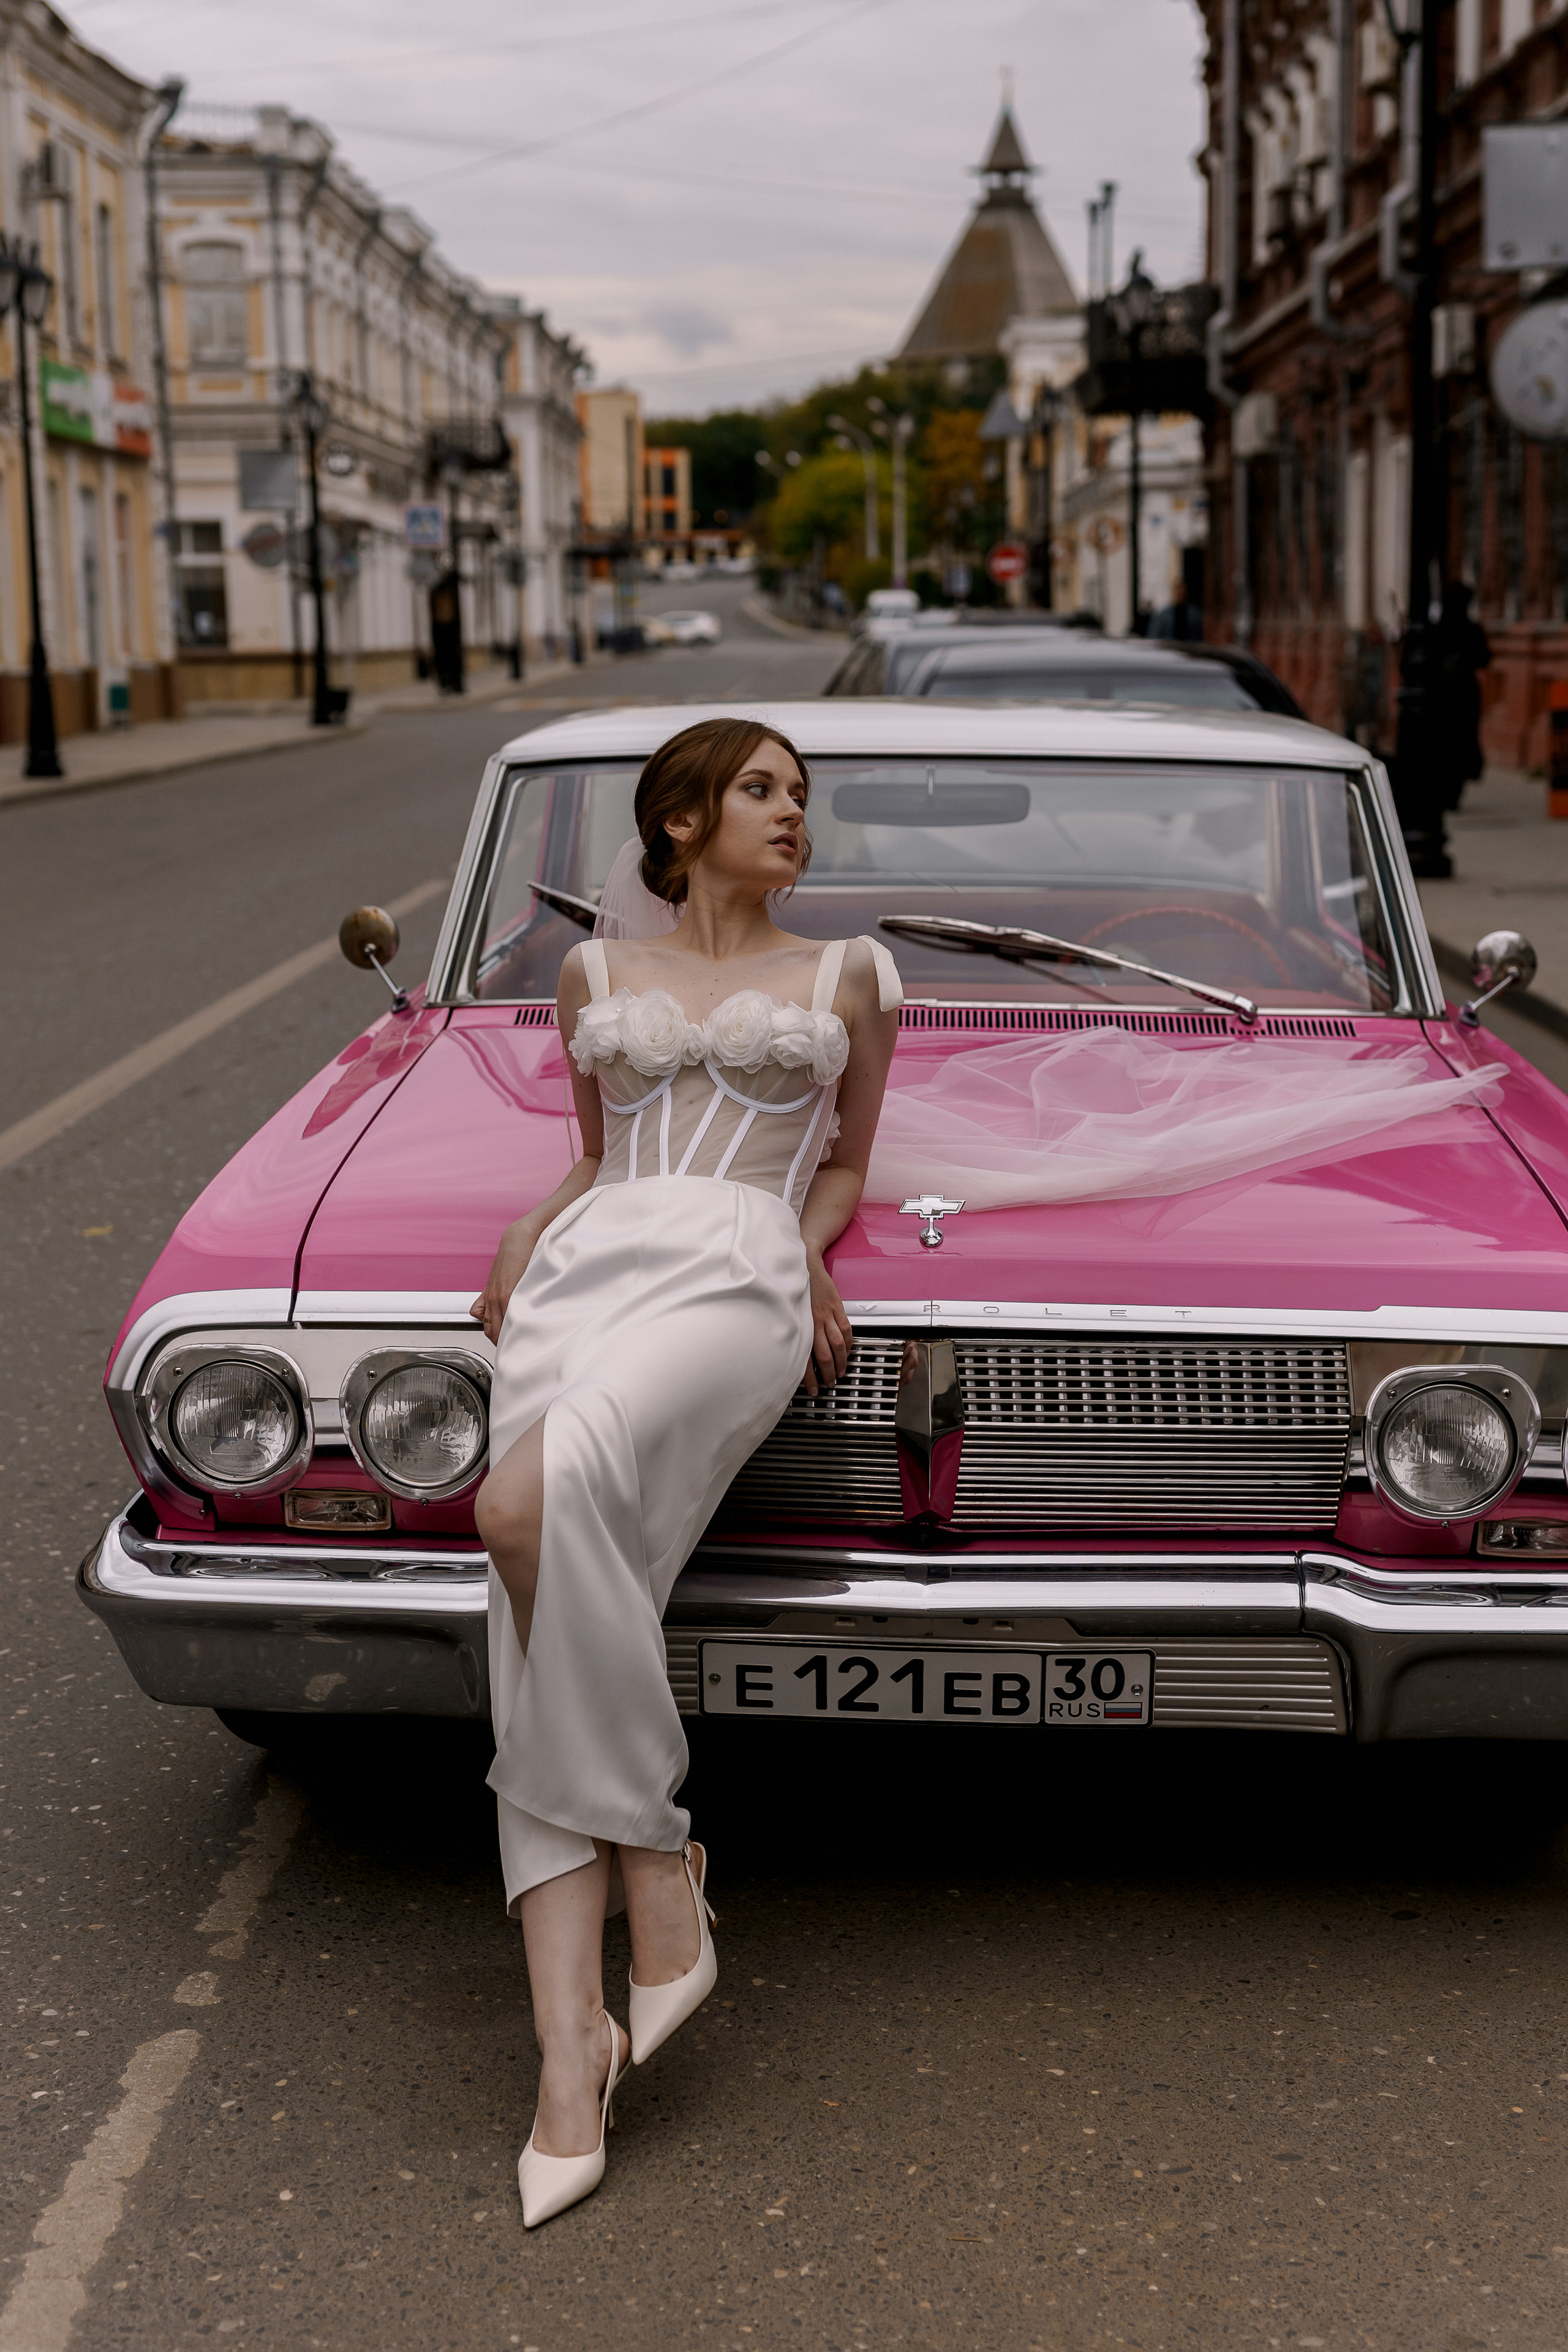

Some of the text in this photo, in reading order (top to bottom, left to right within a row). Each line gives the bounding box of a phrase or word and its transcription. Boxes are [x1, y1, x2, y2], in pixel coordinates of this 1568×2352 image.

[859, 1304, 1192, 1318] VROLET
[1054, 1657, 1125, 1702] 30
[1049, 1702, 1101, 1718] RUS
